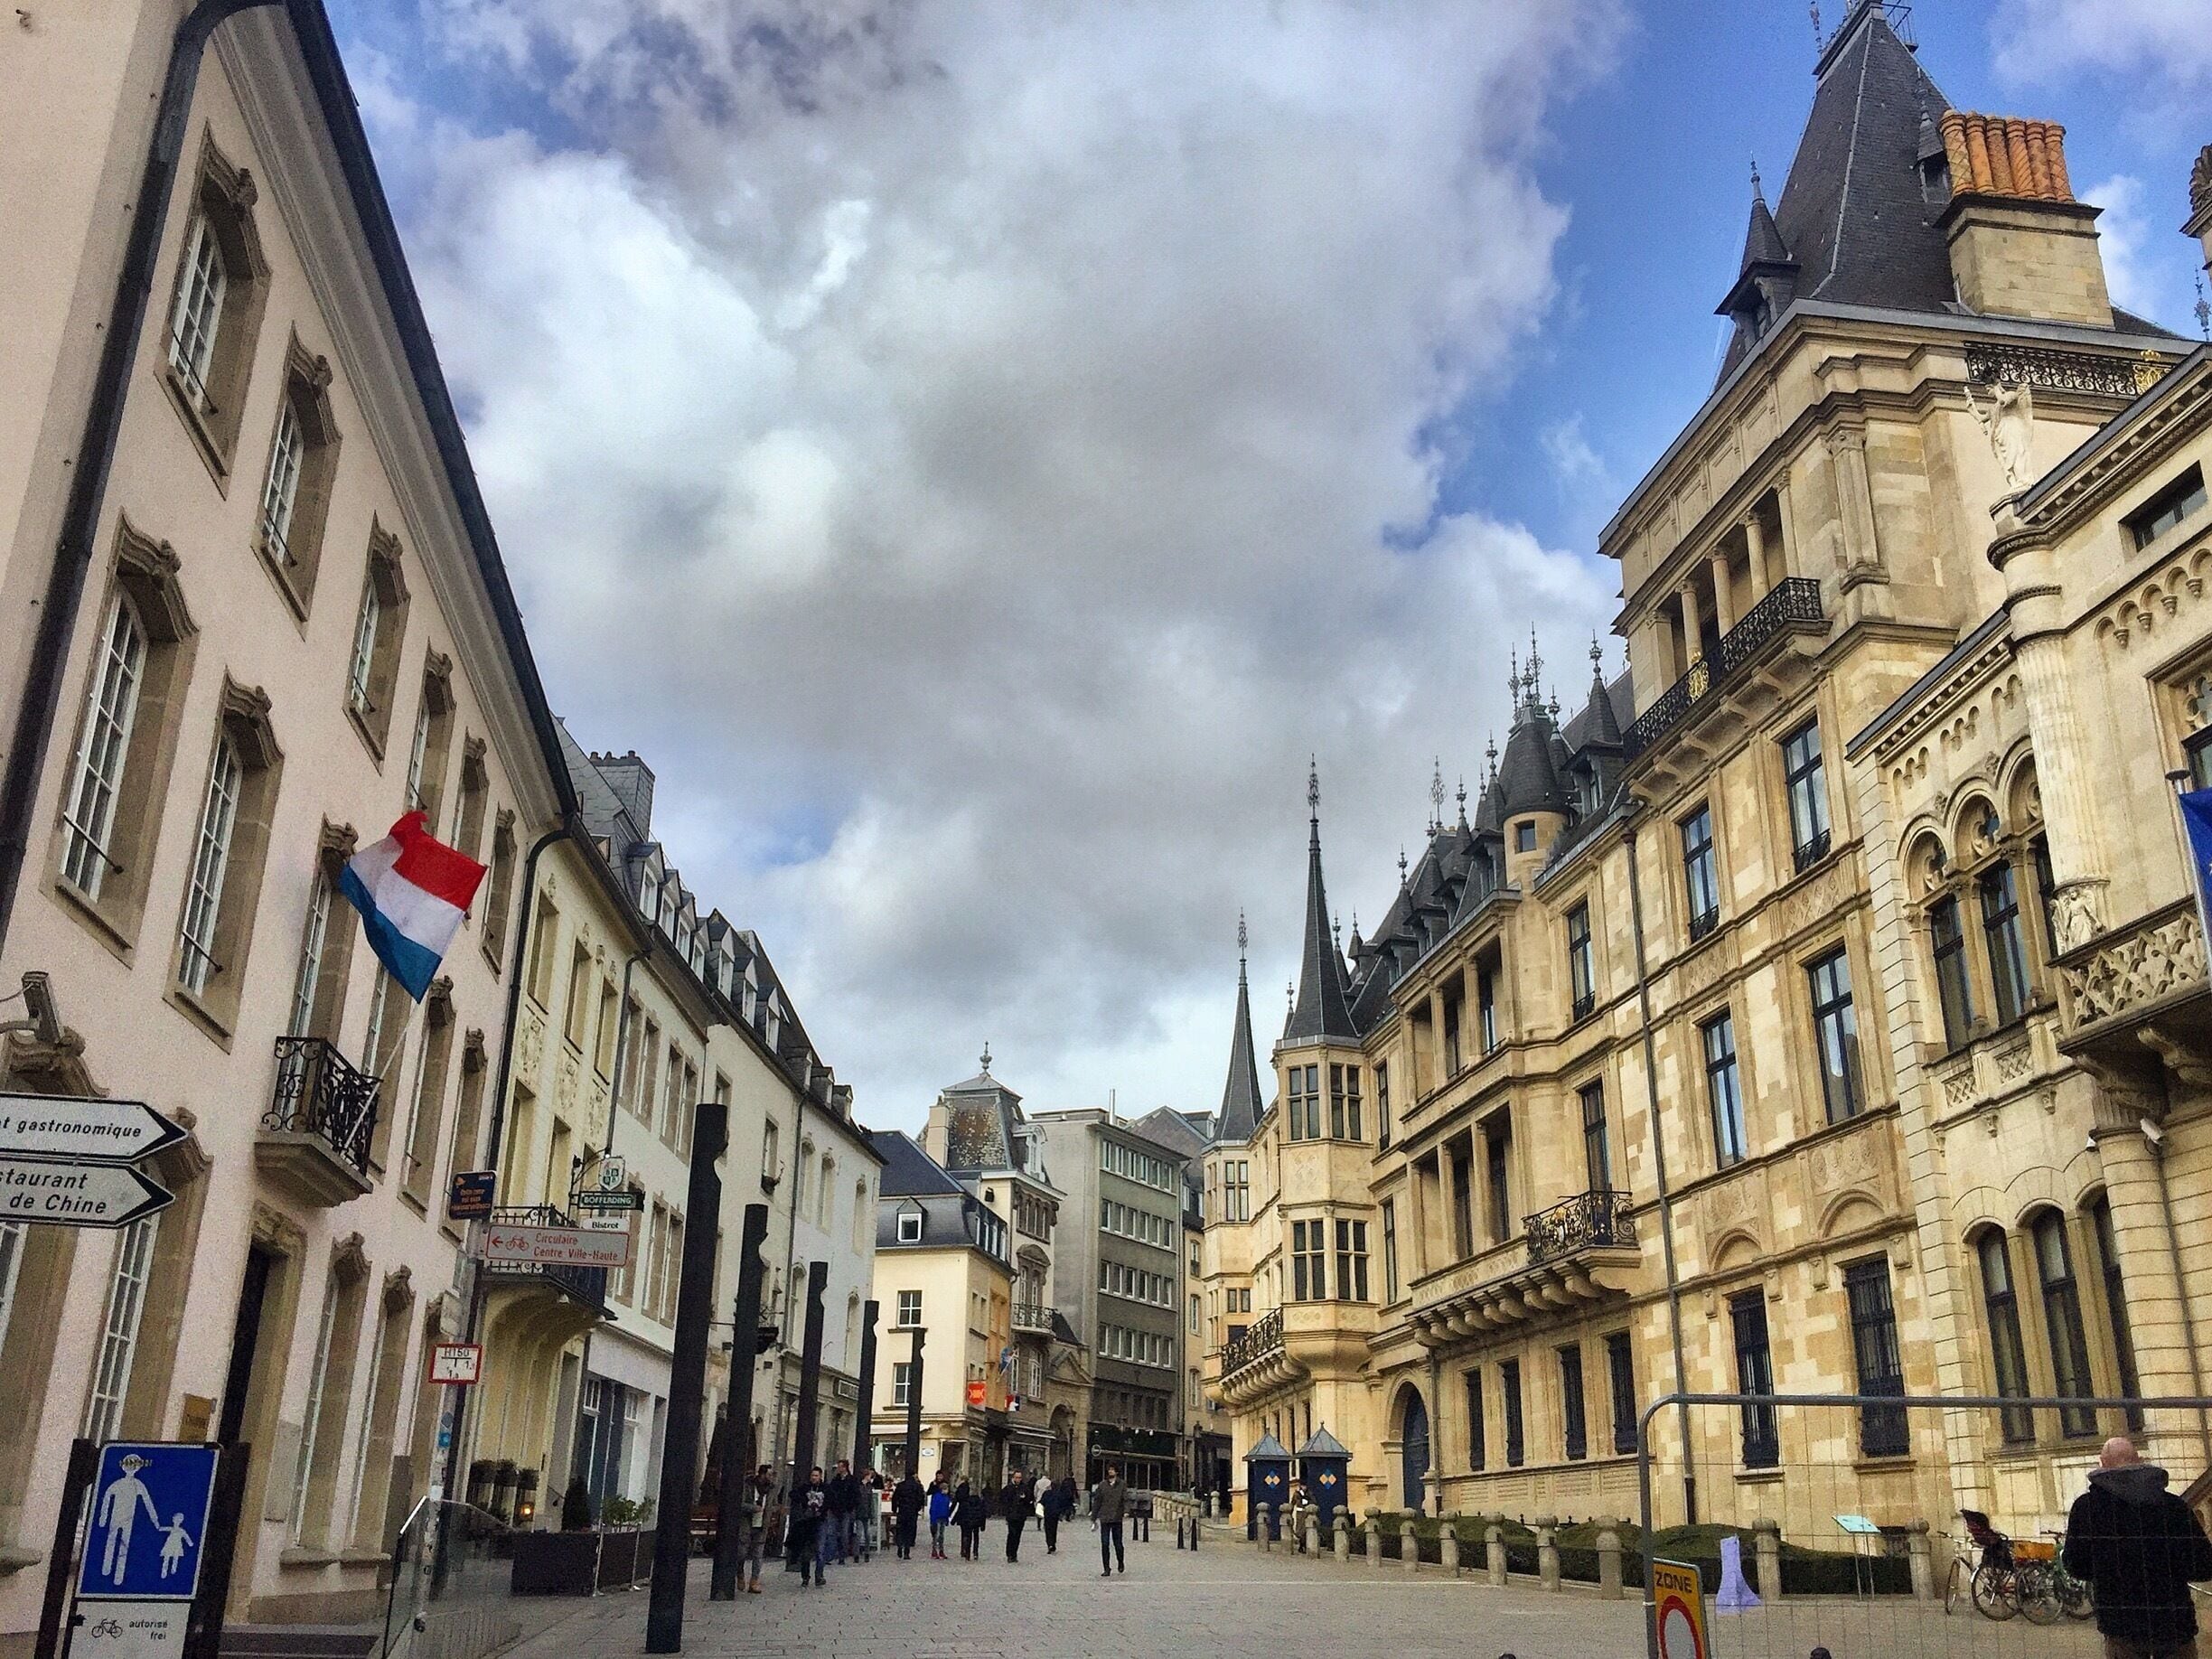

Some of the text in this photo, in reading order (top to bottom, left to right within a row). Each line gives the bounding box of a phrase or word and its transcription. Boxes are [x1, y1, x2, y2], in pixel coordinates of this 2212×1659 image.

[0, 1117, 141, 1139] t gastronomique
[10, 1193, 107, 1214] de Chine
[535, 1233, 578, 1245] Circulaire
[534, 1247, 618, 1261] Centre Ville-Haute
[1655, 1570, 1692, 1593] ZONE
[150, 1631, 166, 1640] frei
